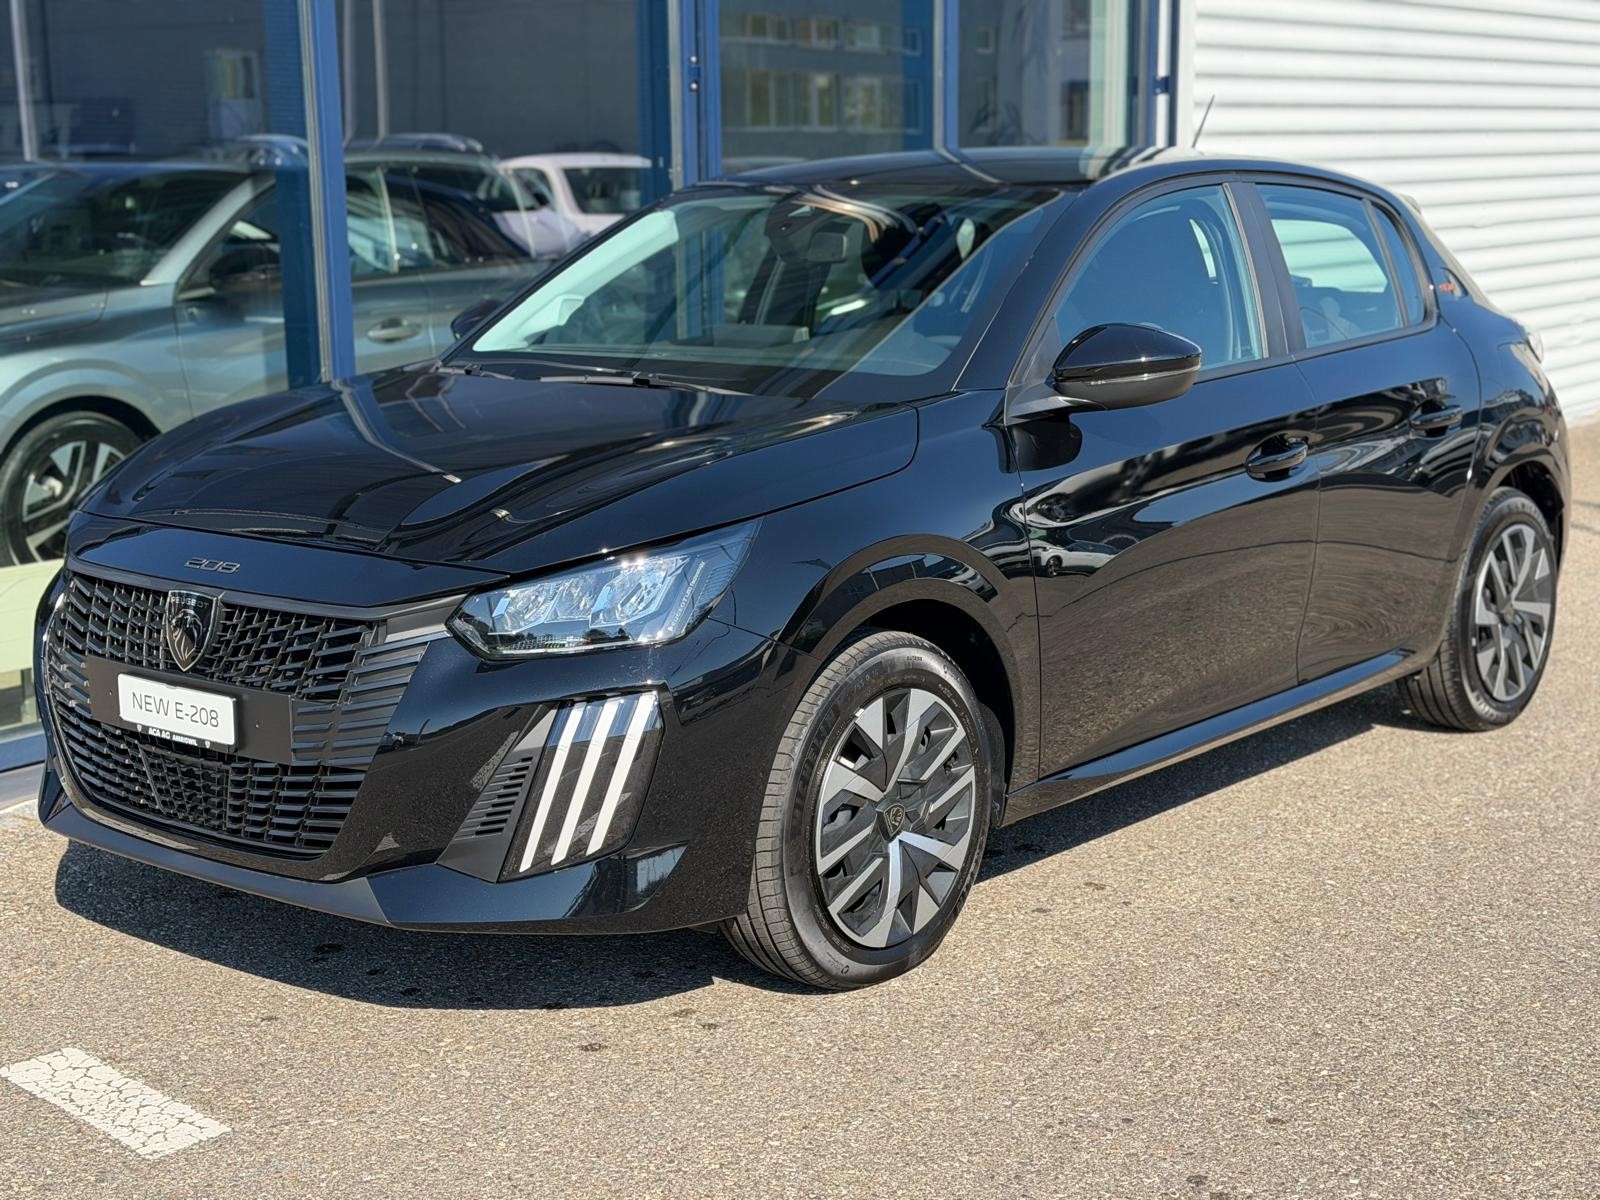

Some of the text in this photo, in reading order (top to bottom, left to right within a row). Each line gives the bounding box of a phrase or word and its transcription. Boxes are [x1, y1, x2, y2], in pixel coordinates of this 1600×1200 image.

[184, 557, 240, 573] 208
[170, 596, 209, 609] PEUGEOT
[132, 692, 219, 727] NEW E-208
[148, 727, 160, 737] ACA
